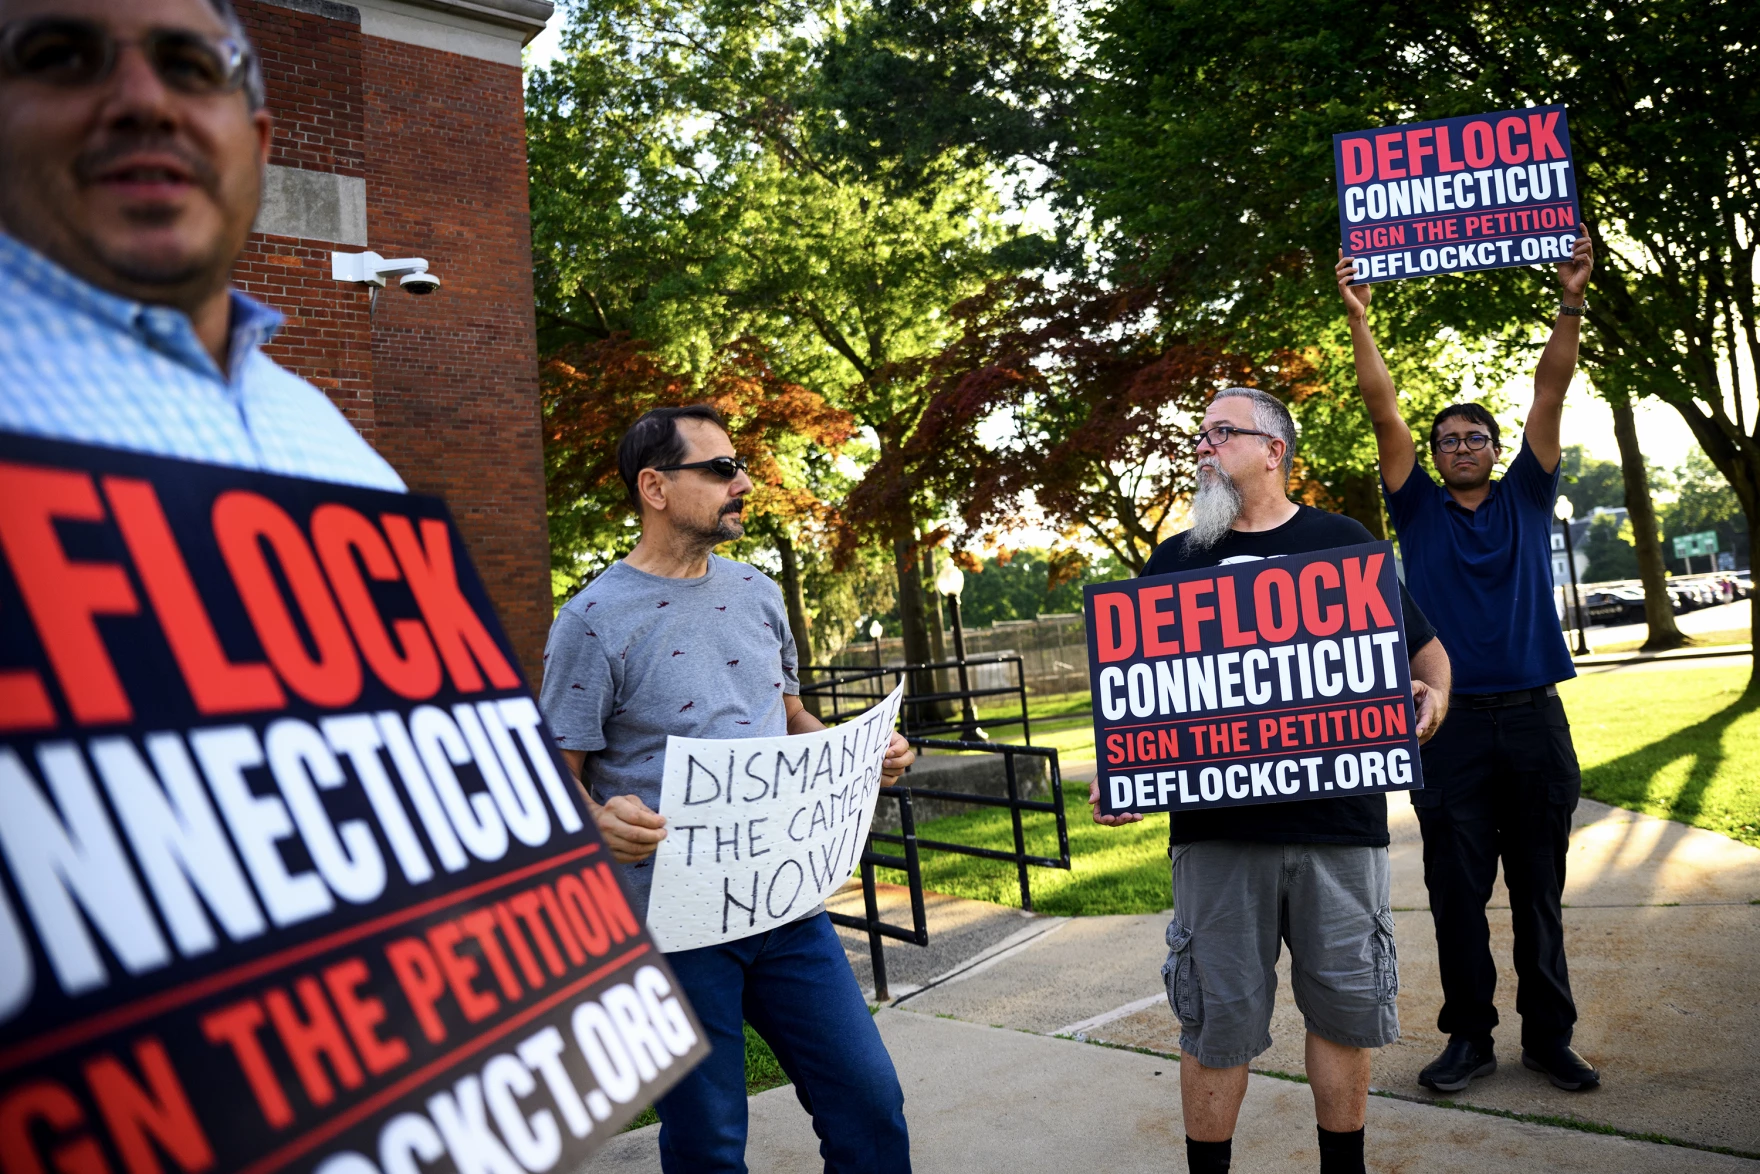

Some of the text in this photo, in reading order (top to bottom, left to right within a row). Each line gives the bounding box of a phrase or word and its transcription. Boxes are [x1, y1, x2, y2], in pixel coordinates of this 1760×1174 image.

[1341, 111, 1566, 185] DEFLOCK
[1345, 161, 1569, 222] CONNECTICUT
[1350, 206, 1574, 250] SIGN THE PETITION
[1352, 234, 1576, 280] DEFLOCKCT.ORG
[1094, 553, 1395, 663] DEFLOCK
[1099, 631, 1399, 720] CONNECTICUT
[1106, 703, 1407, 764] SIGN THE PETITION
[1109, 748, 1412, 808] DEFLOCKCT.ORG
[0, 697, 583, 1024] NNECTICUT
[675, 817, 770, 866] THE
[722, 810, 862, 933] NOW!
[203, 956, 410, 1129] THE
[385, 861, 640, 1044] PETITION
